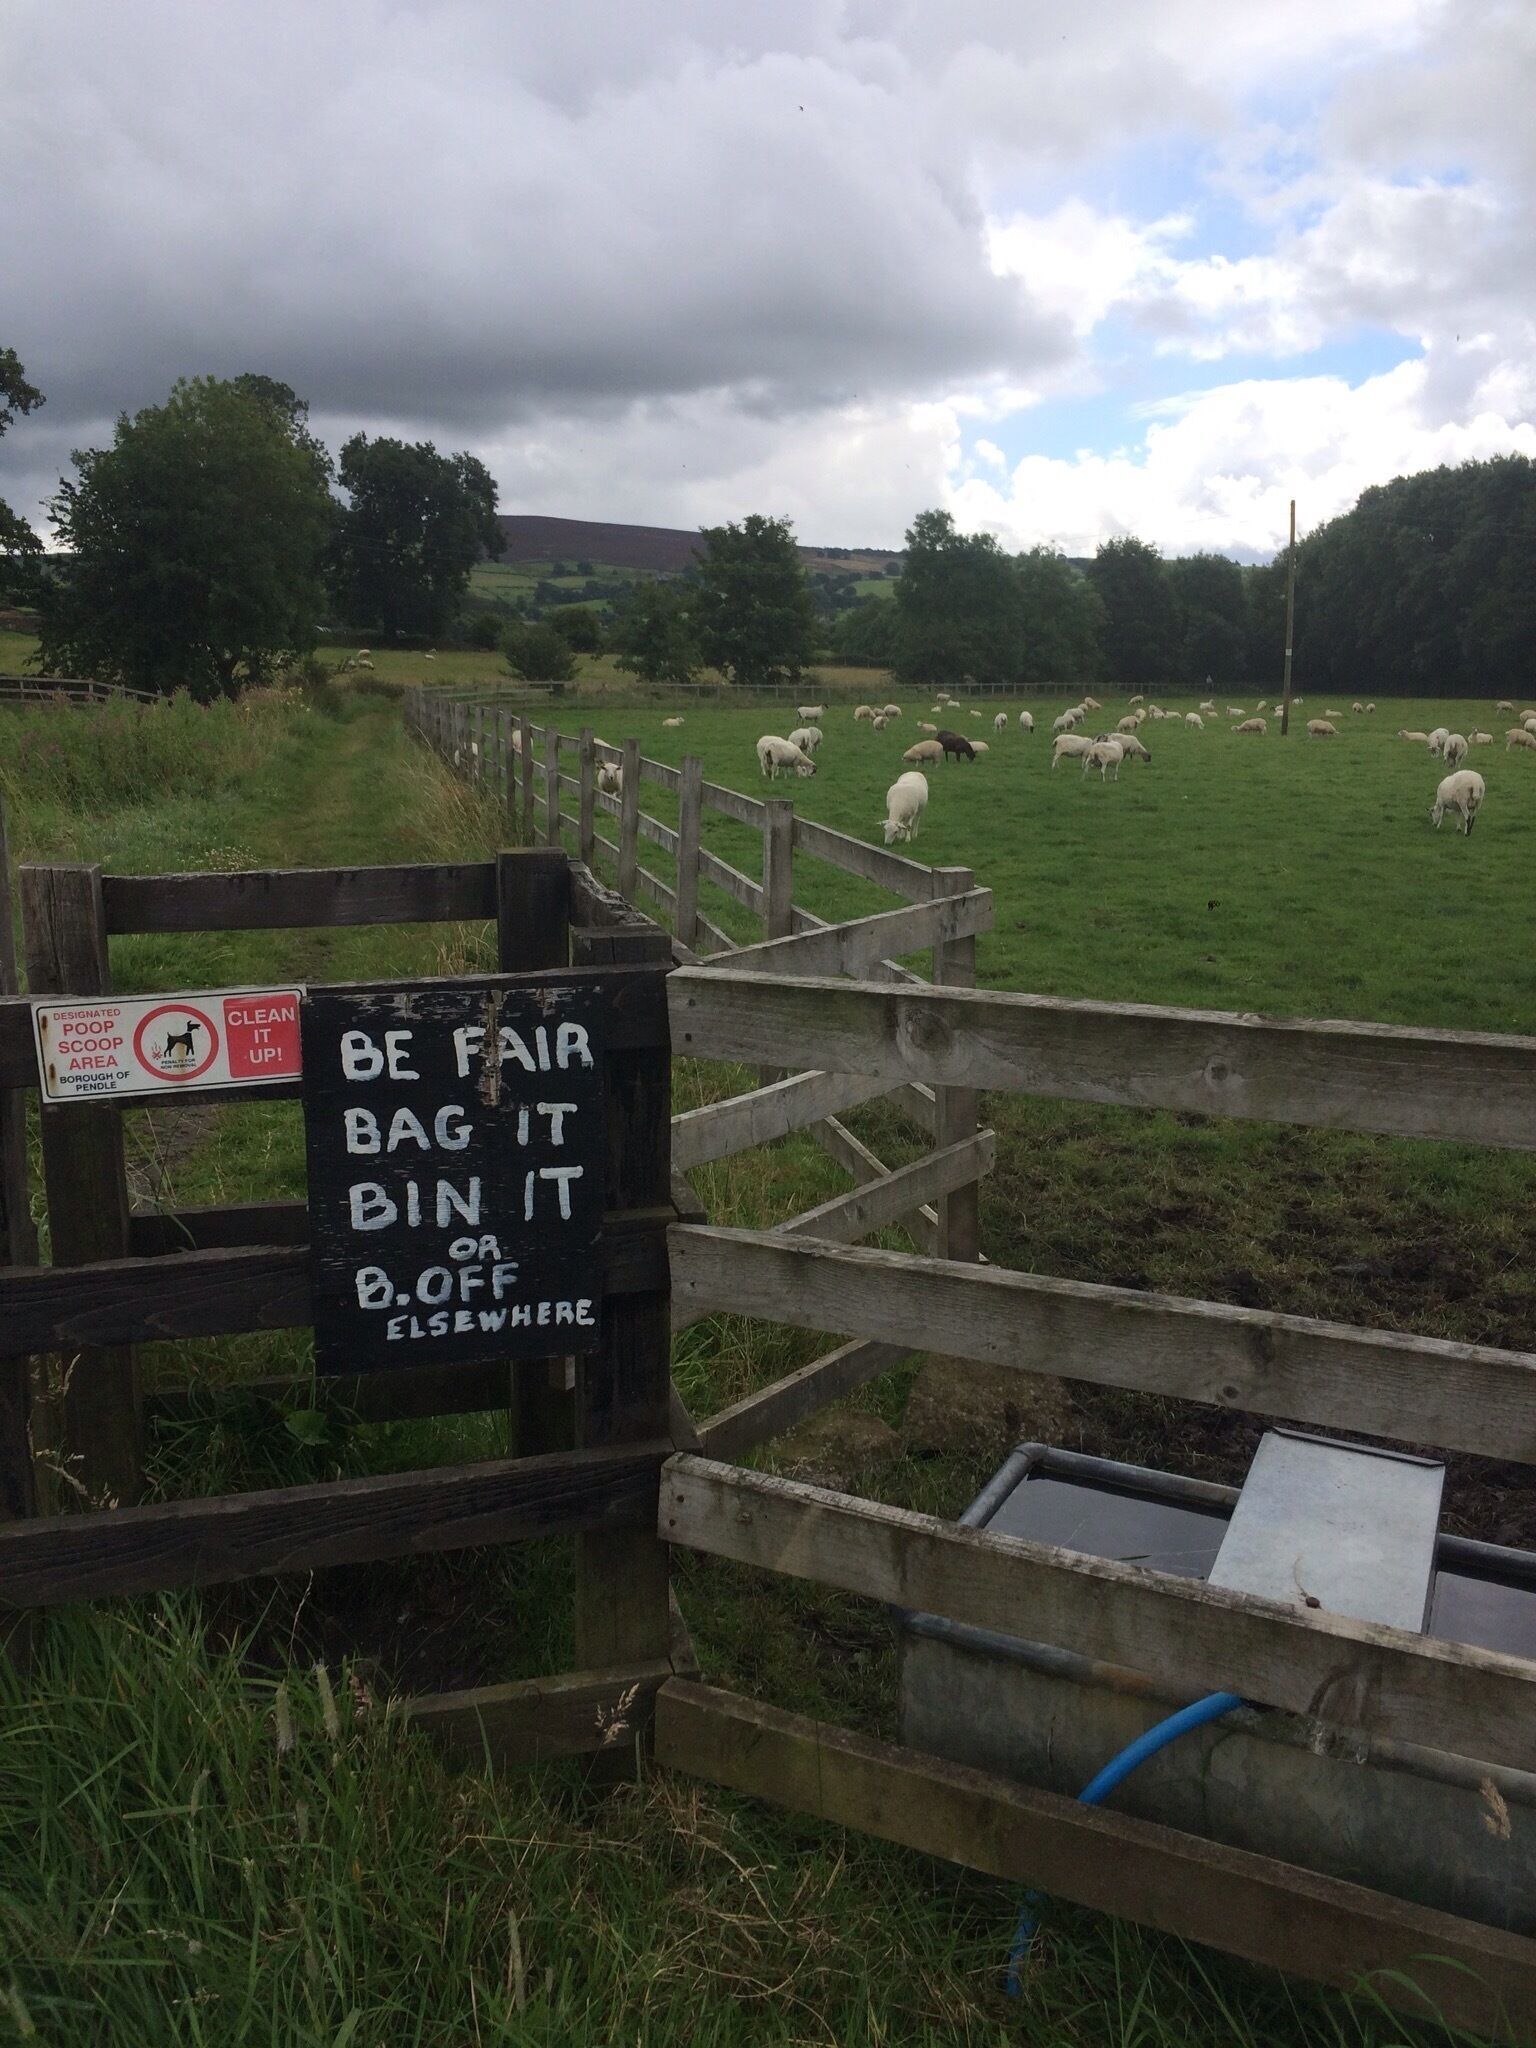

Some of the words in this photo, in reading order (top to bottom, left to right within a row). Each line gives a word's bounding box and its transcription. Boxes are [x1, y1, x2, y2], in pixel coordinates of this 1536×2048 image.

[53, 1008, 121, 1021] DESIGNATED
[227, 1006, 295, 1026] CLEAN
[63, 1020, 115, 1036] POOP
[254, 1028, 272, 1044] IT
[58, 1037, 124, 1055] SCOOP
[340, 1030, 420, 1081] BE
[453, 1022, 594, 1078] FAIR
[69, 1054, 118, 1071] AREA
[249, 1047, 282, 1064] UP!
[59, 1073, 114, 1085] BOROUGH
[116, 1071, 131, 1080] OF
[76, 1081, 117, 1092] PENDLE
[343, 1105, 473, 1154] BAG
[517, 1102, 578, 1146] IT
[348, 1176, 482, 1231] BIN
[524, 1165, 584, 1221] IT
[448, 1234, 501, 1260] OR
[386, 1299, 596, 1341] ELSEWHERE
